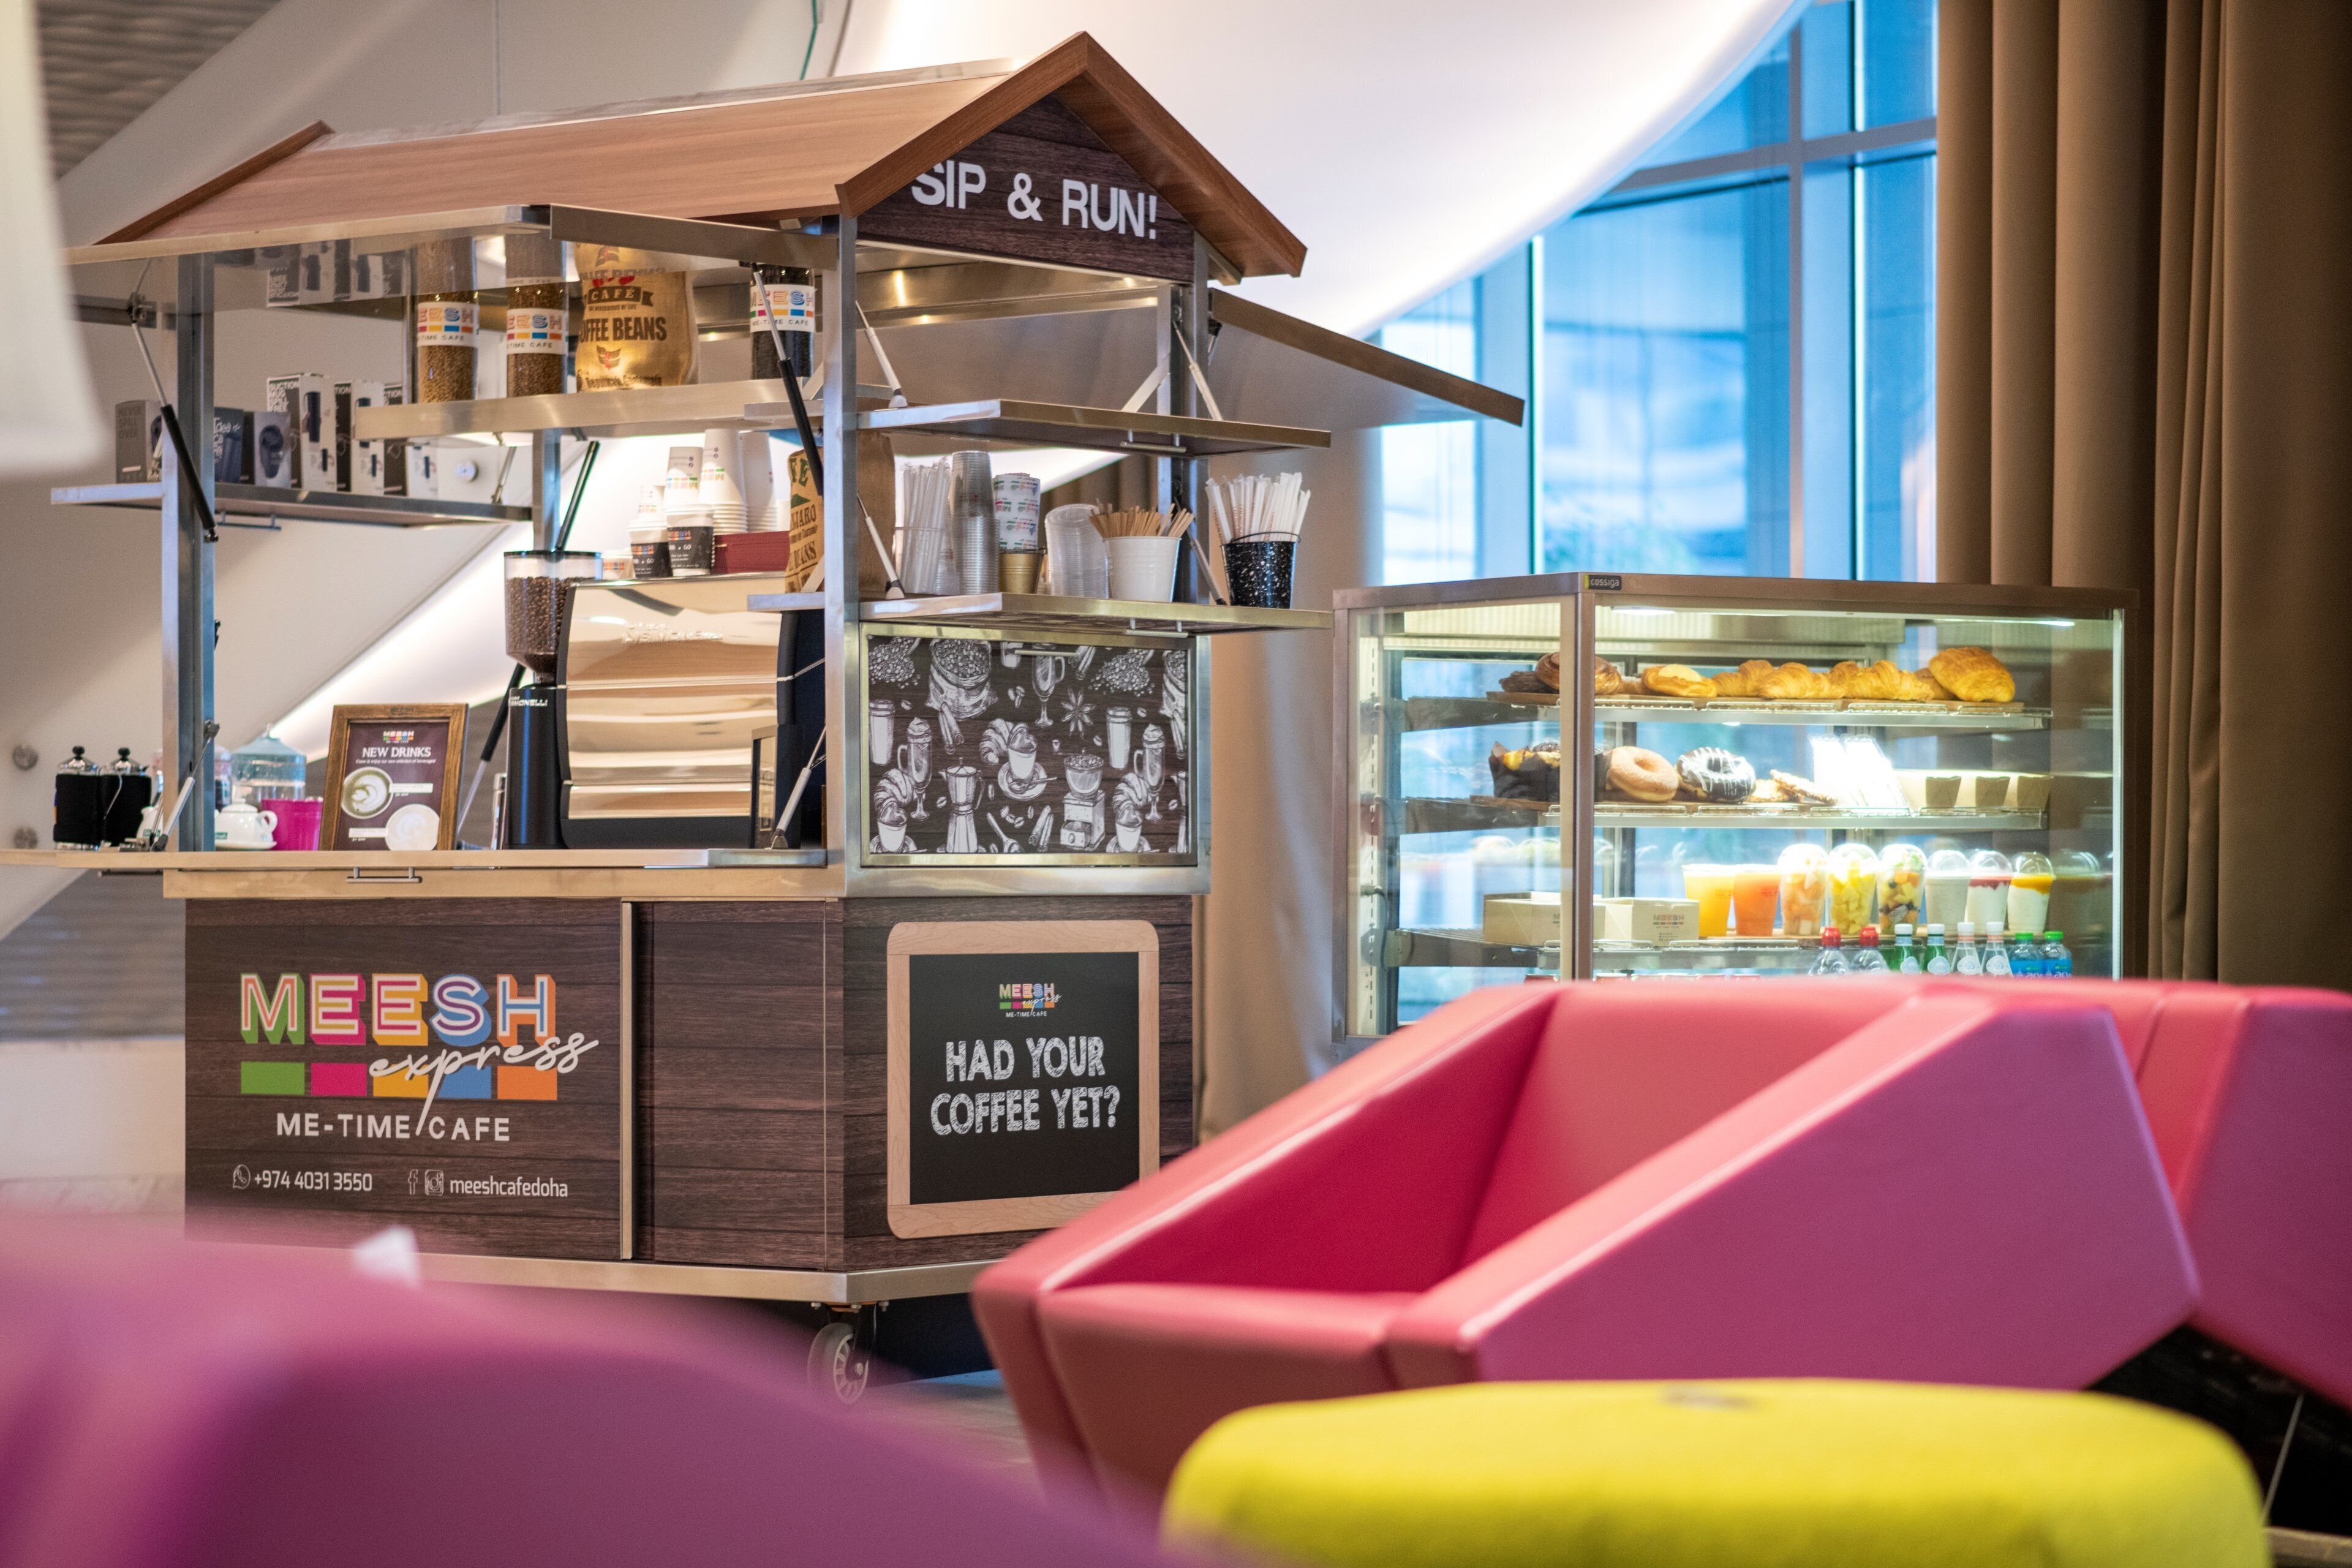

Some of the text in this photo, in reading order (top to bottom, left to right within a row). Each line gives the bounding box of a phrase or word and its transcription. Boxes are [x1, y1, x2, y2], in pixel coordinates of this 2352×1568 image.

[911, 160, 1158, 240] SIP & RUN!
[418, 307, 474, 323] EESH
[507, 314, 562, 331] EESH
[579, 317, 667, 342] OFFEE BEANS
[1590, 578, 1619, 588] cossiga
[362, 747, 432, 758] NEW DRINKS
[999, 983, 1055, 999] MEESH
[241, 973, 556, 1047] MEESH
[946, 1035, 1106, 1082] HAD YOUR
[369, 1033, 599, 1136] express
[930, 1085, 1121, 1136] COFFEE YET?
[277, 1113, 510, 1142] ME-TIME CAFE
[254, 1170, 372, 1192] +974 4031 3550
[450, 1175, 568, 1198] meeshcafedoha
